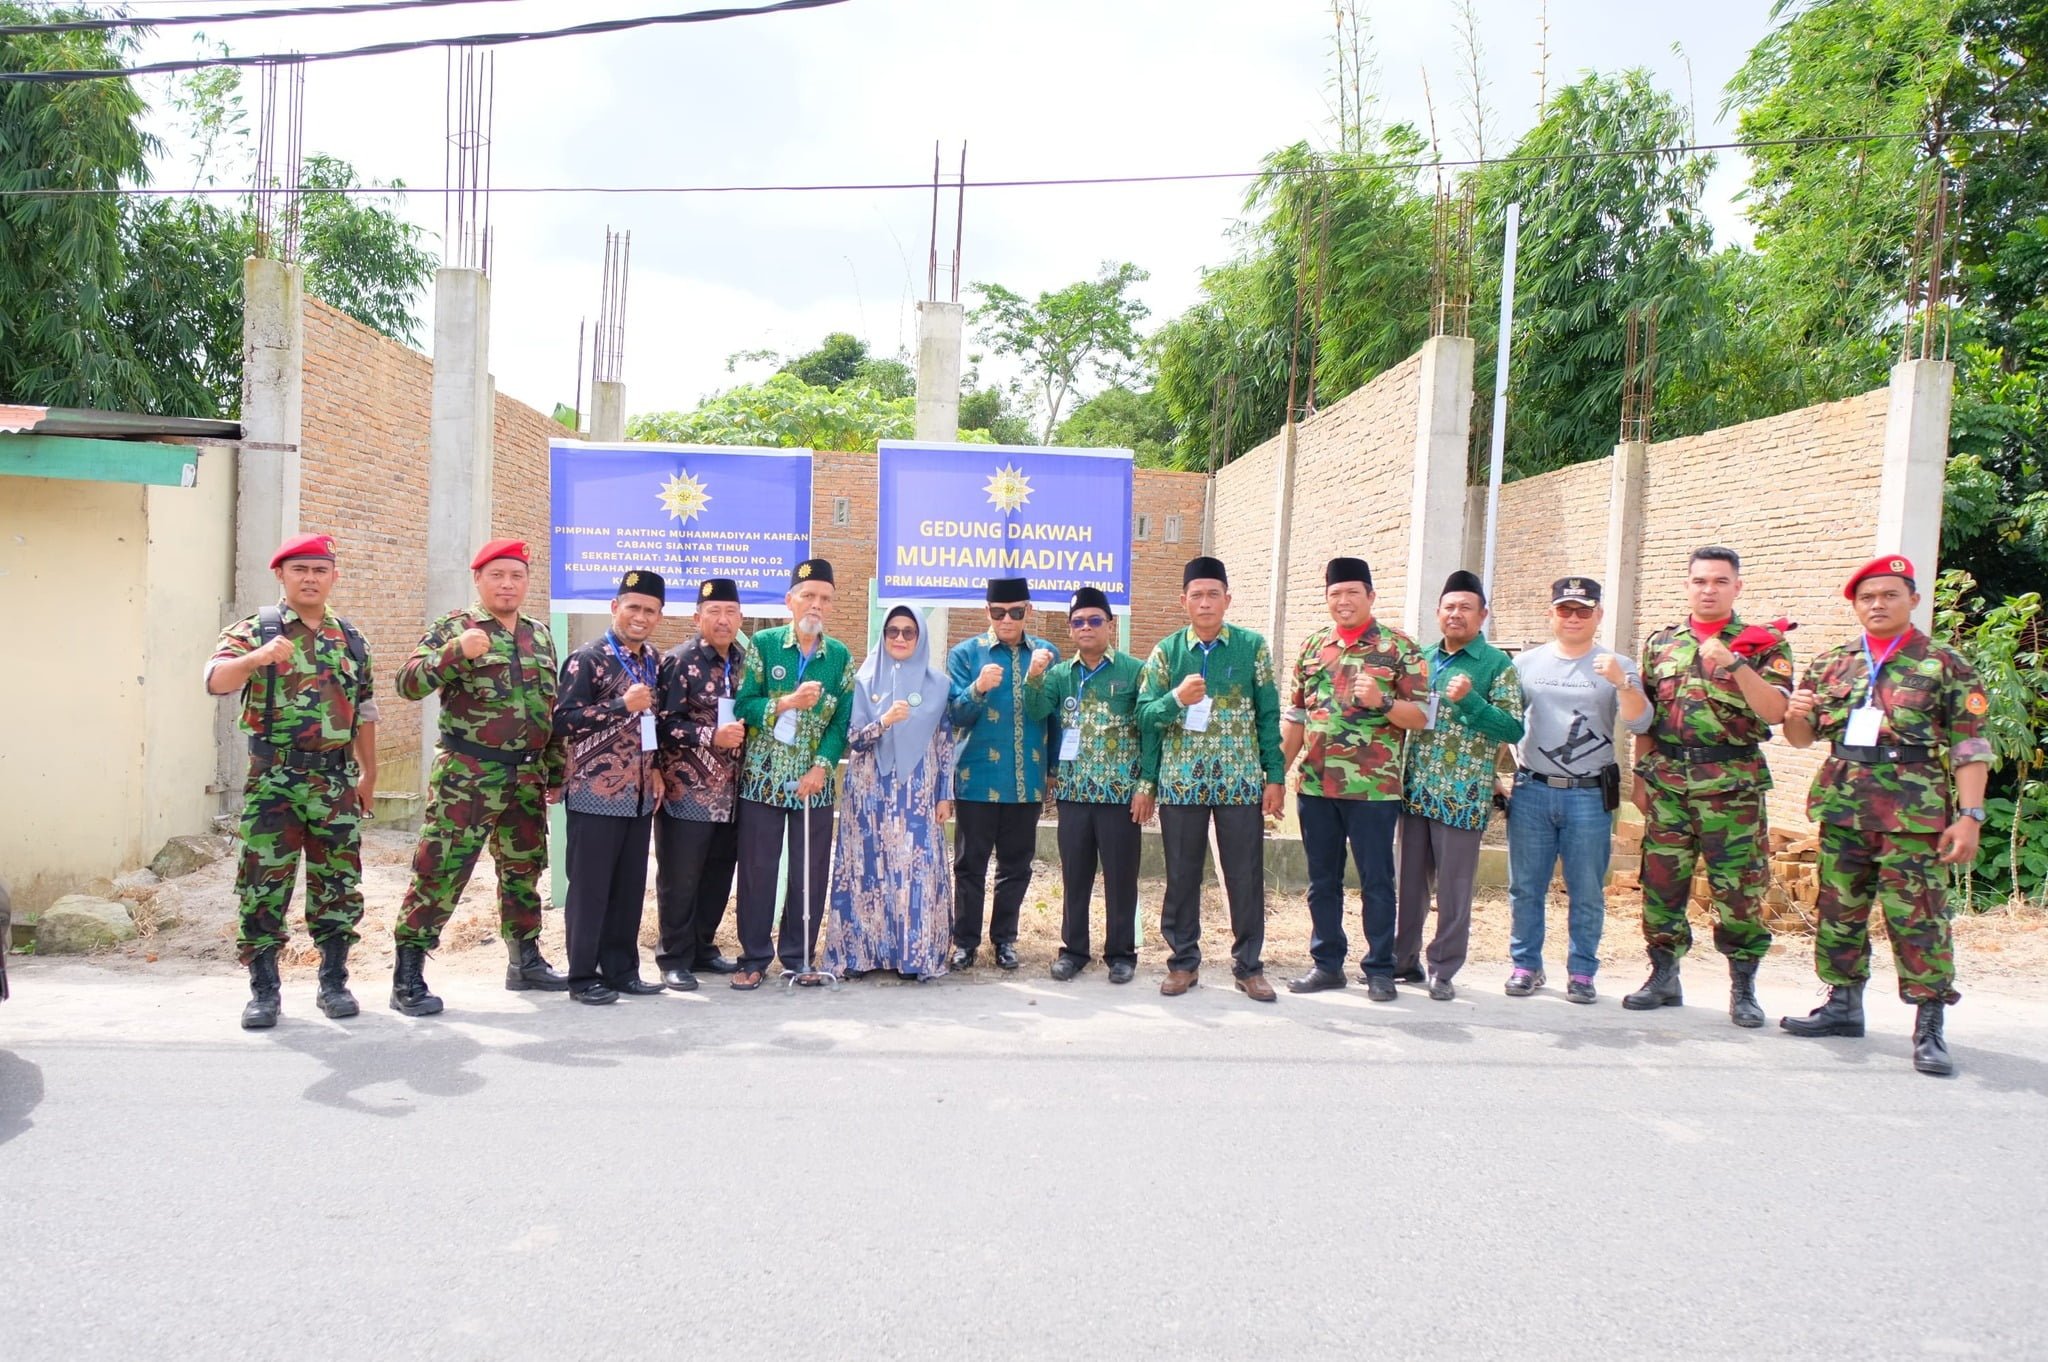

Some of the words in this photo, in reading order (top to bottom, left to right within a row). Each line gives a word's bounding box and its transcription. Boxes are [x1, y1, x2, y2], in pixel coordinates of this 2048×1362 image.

[555, 527, 610, 536] PIMPINAN
[616, 528, 666, 538] RANTING
[669, 530, 761, 540] MUHAMMADIYAH
[763, 532, 809, 541] KAHEAN
[919, 520, 1002, 539] GEDUNG
[1008, 523, 1092, 542] DAKWAH
[616, 540, 662, 550] CABANG
[665, 541, 713, 551] SIANTAR
[716, 543, 750, 553] TIMUR
[581, 551, 661, 561] SEKRETARIAT:
[663, 554, 699, 563] JALAN
[702, 555, 748, 564] MERBOU
[750, 556, 783, 565] NO.02
[896, 545, 1114, 573] MUHAMMADIYAH
[564, 562, 633, 573] KELURAHAN
[636, 565, 682, 575] KAHEAN
[685, 566, 710, 575] KEC.
[712, 568, 760, 577] SIANTAR
[762, 568, 791, 577] UTAR
[884, 575, 913, 587] PRM
[915, 575, 969, 589] KAHEAN
[1027, 578, 1081, 591] SIANTAR
[1083, 580, 1125, 593] TIMUR
